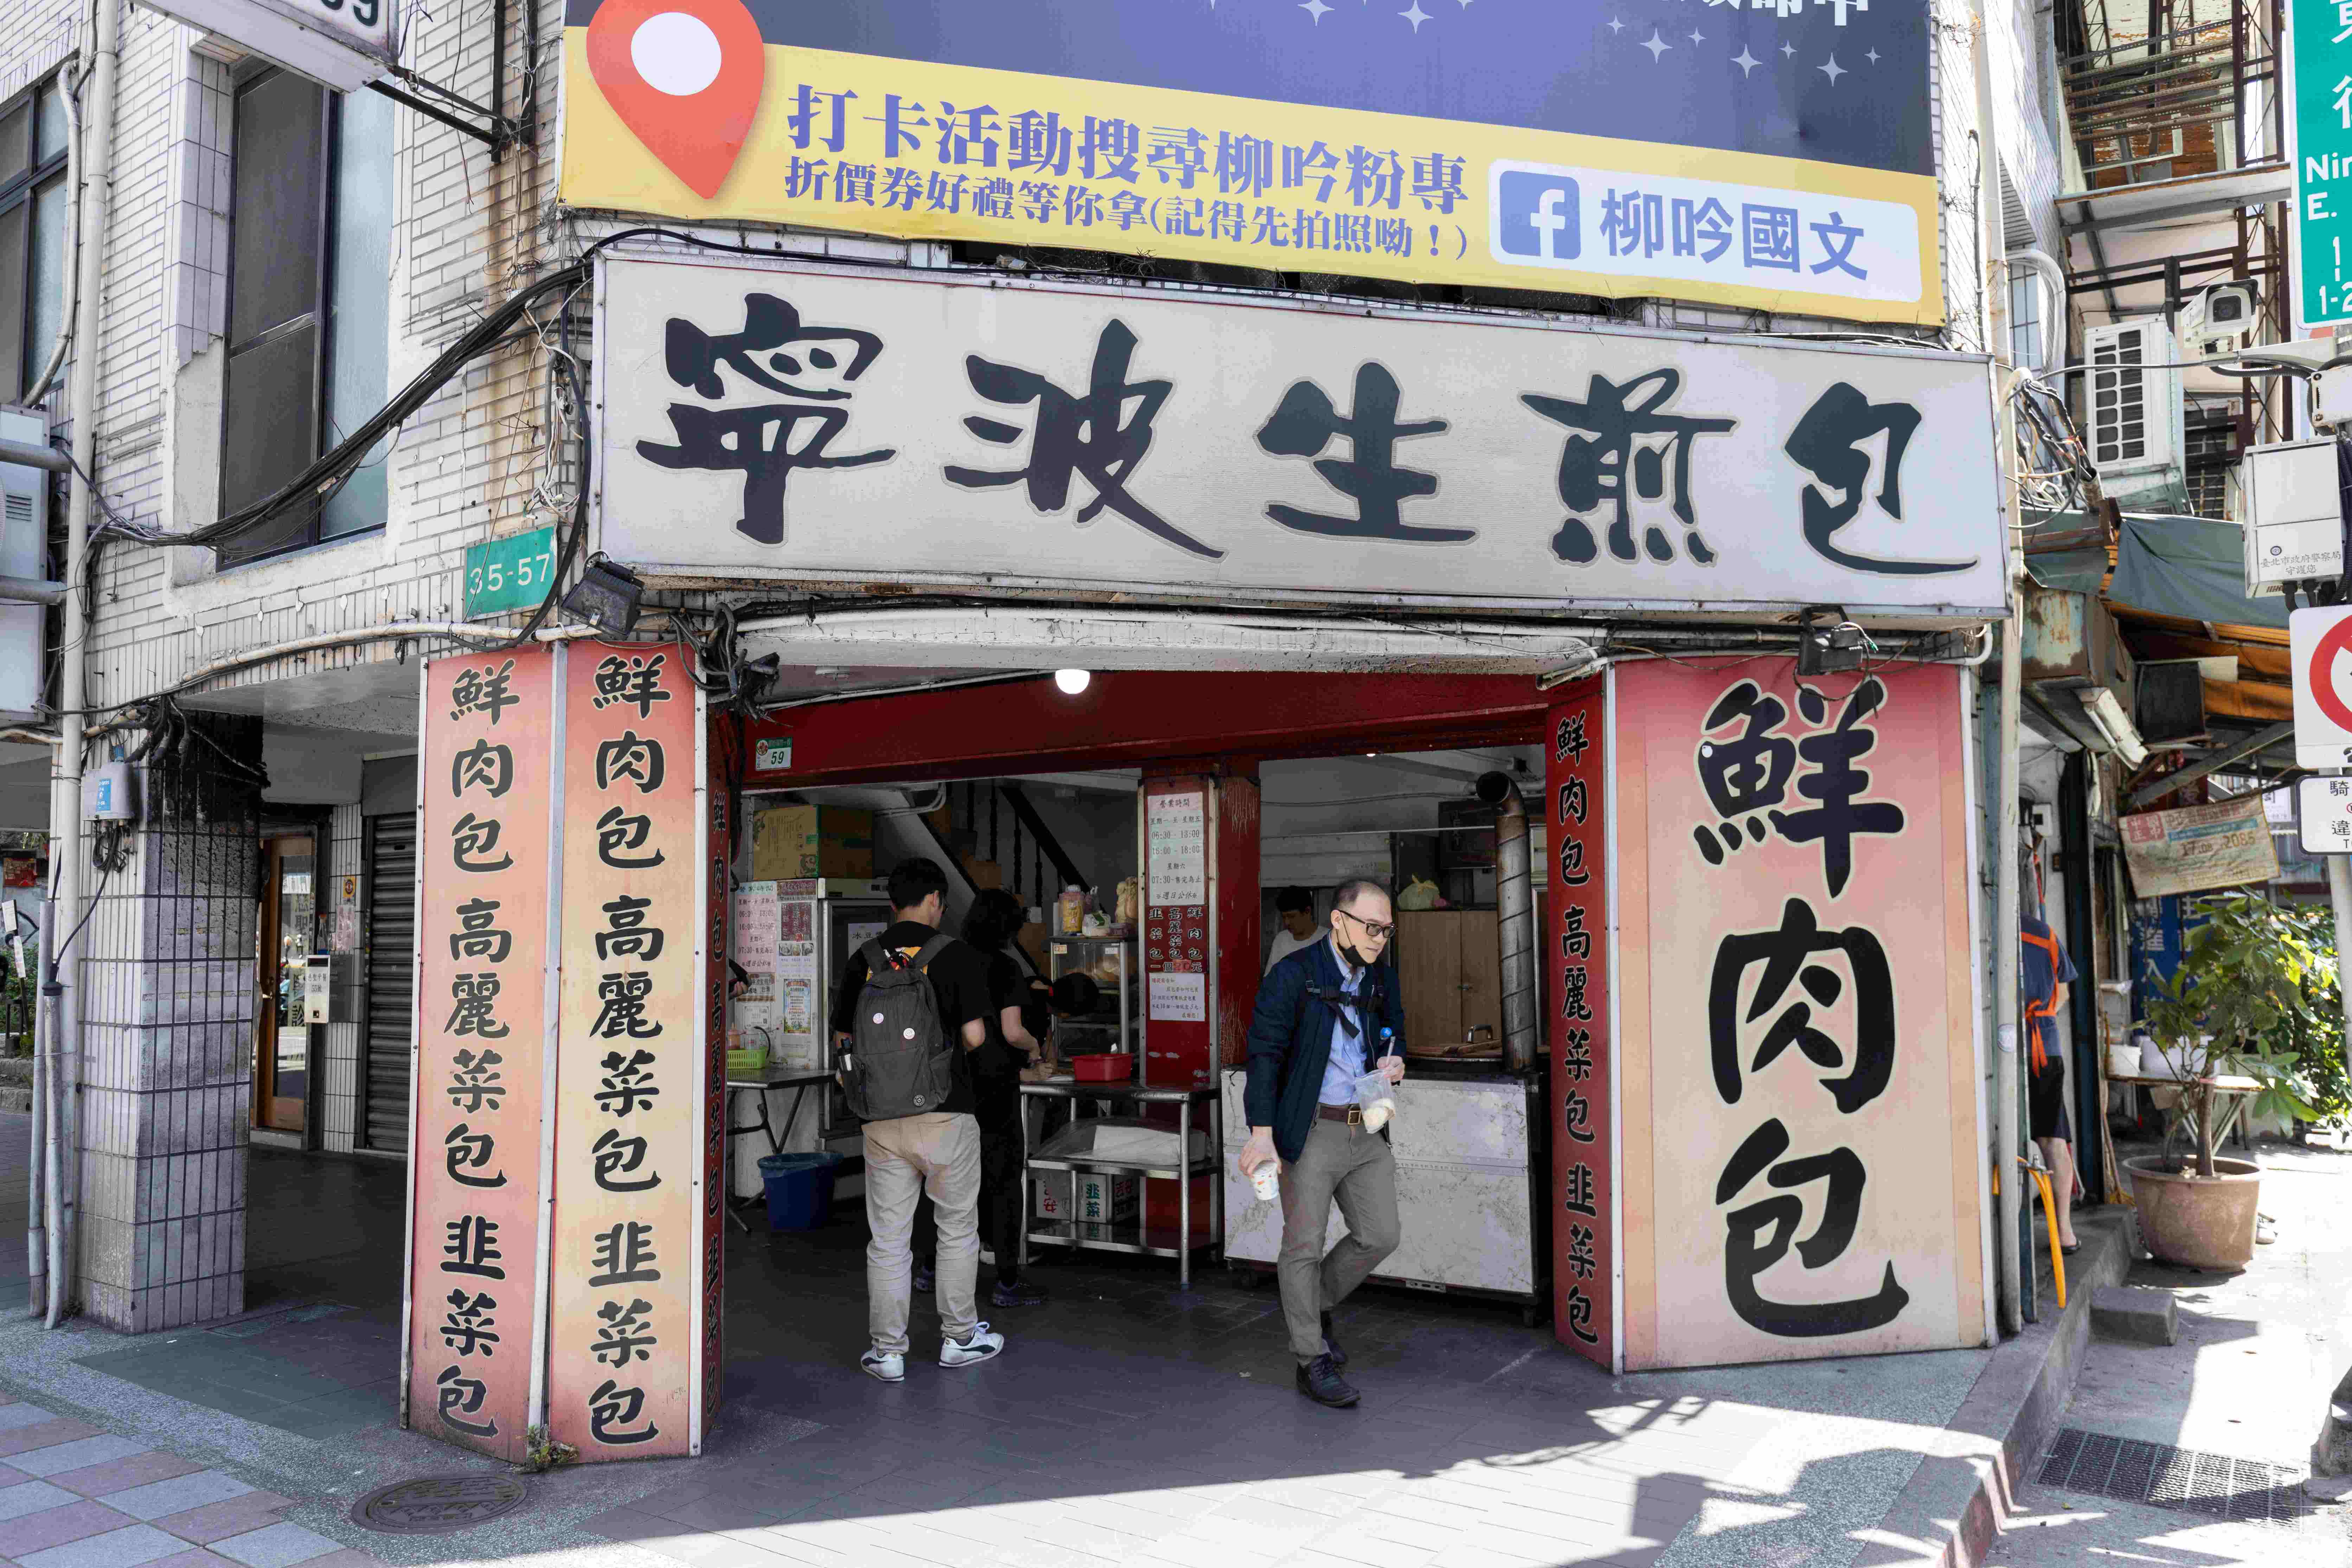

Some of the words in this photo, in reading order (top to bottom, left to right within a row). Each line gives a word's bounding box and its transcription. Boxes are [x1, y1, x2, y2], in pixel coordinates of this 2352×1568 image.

[787, 84, 1468, 215] 打卡活動搜尋柳吟粉專
[1600, 187, 1868, 281] 柳吟國文
[2307, 192, 2337, 220] E.
[635, 292, 1978, 575] 寧波生煎包
[469, 553, 550, 595] 35-57
[451, 658, 521, 875] 鮮肉包
[591, 652, 672, 871] 鮮肉包
[771, 751, 784, 764] 59
[1160, 798, 1190, 808] 營業時間
[1555, 709, 1591, 888] 鮮肉包
[2330, 780, 2350, 796] 騎
[1152, 831, 1171, 839] 06:30
[1152, 846, 1171, 855] 16:00
[1181, 845, 1200, 854] 18:00
[2332, 820, 2351, 836] 違
[2343, 839, 2352, 849] T
[1148, 907, 1164, 960] 韭菜包
[1168, 907, 1183, 960] 高麗菜包
[1186, 906, 1203, 960] 鮮肉包
[443, 897, 513, 1190] 高麗菜包
[589, 895, 665, 1193] 高麗菜包
[1560, 905, 1596, 1145] 高麗菜包
[1693, 677, 1911, 1339] 鮮肉包
[1565, 1161, 1599, 1348] 韭菜包
[436, 1215, 504, 1438] 韭菜包
[587, 1223, 661, 1447] 韭菜包
